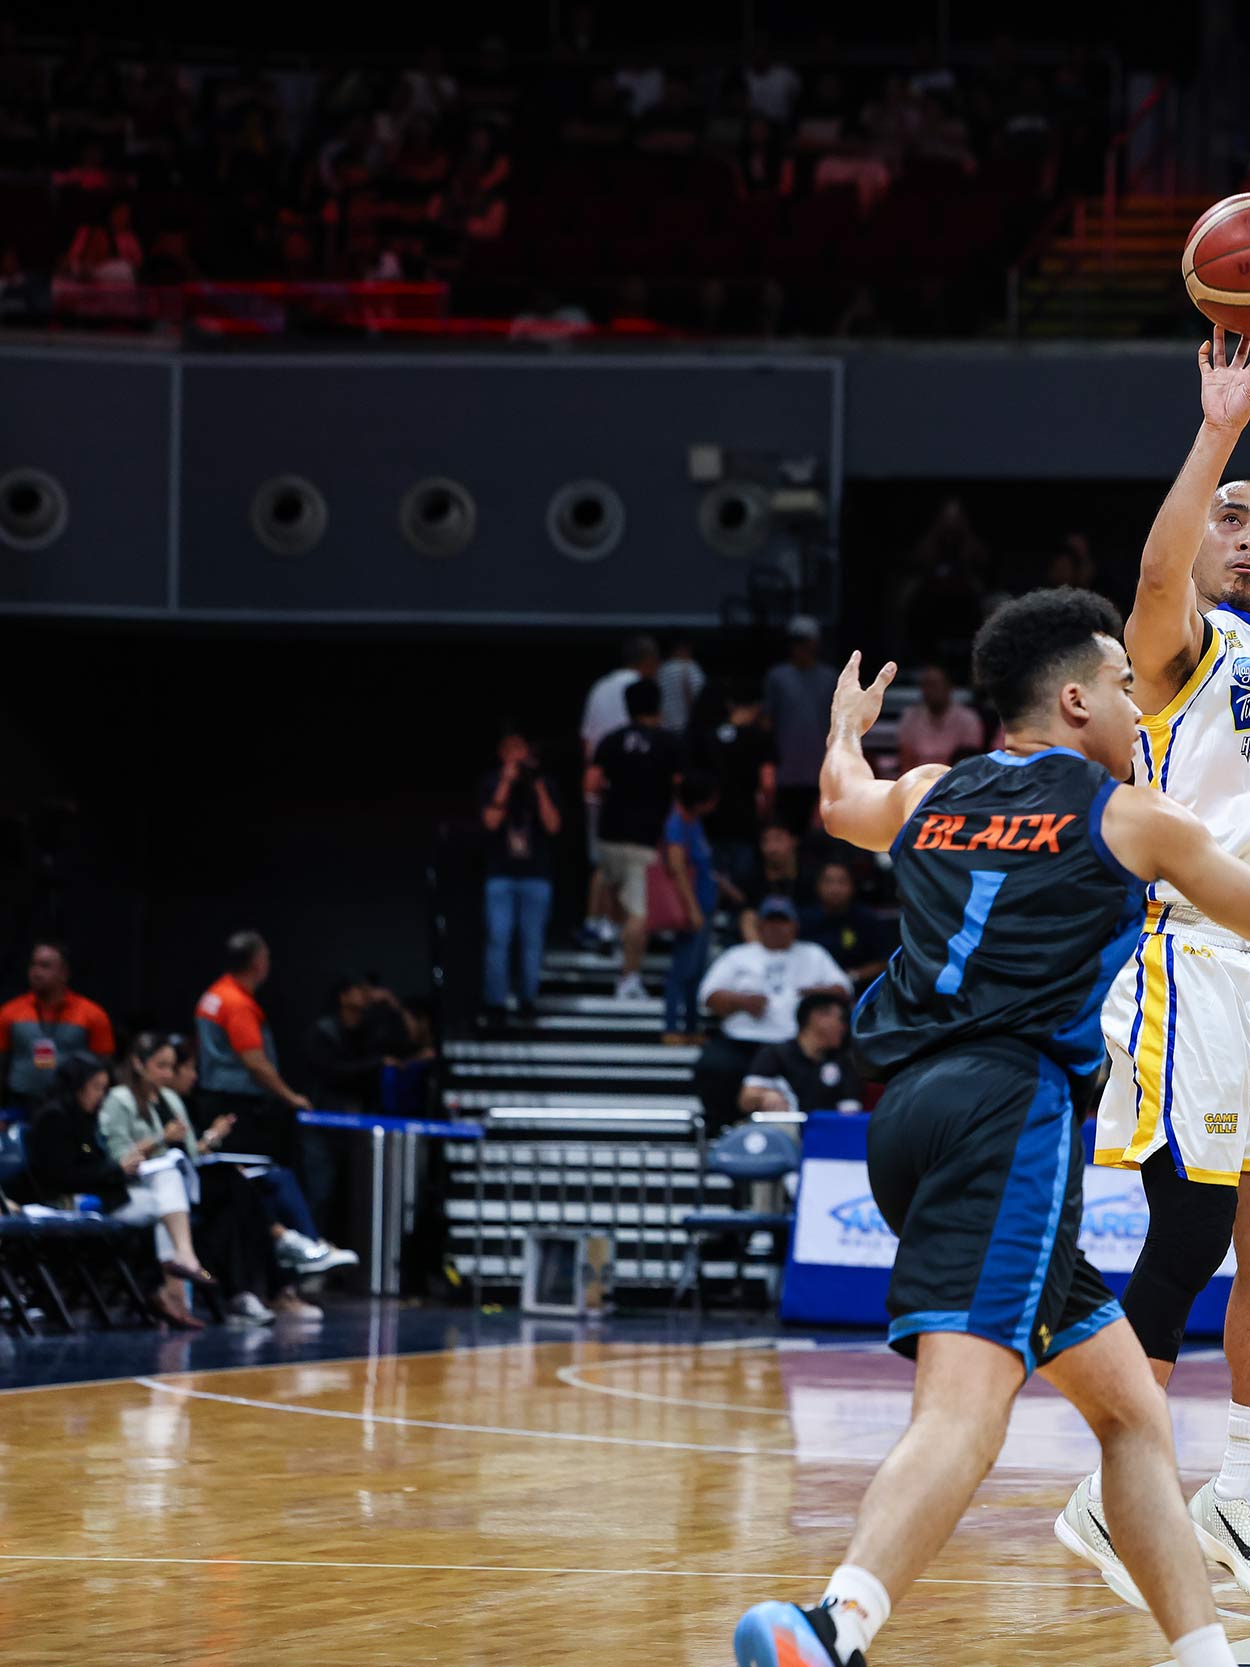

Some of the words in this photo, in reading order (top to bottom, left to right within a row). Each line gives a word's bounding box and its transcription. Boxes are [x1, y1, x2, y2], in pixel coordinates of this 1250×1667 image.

[913, 813, 1077, 853] BLACK
[935, 869, 1008, 995] 1
[1203, 1112, 1239, 1124] GAME
[1205, 1123, 1237, 1134] VILLE
[1082, 1211, 1149, 1237] ARE
